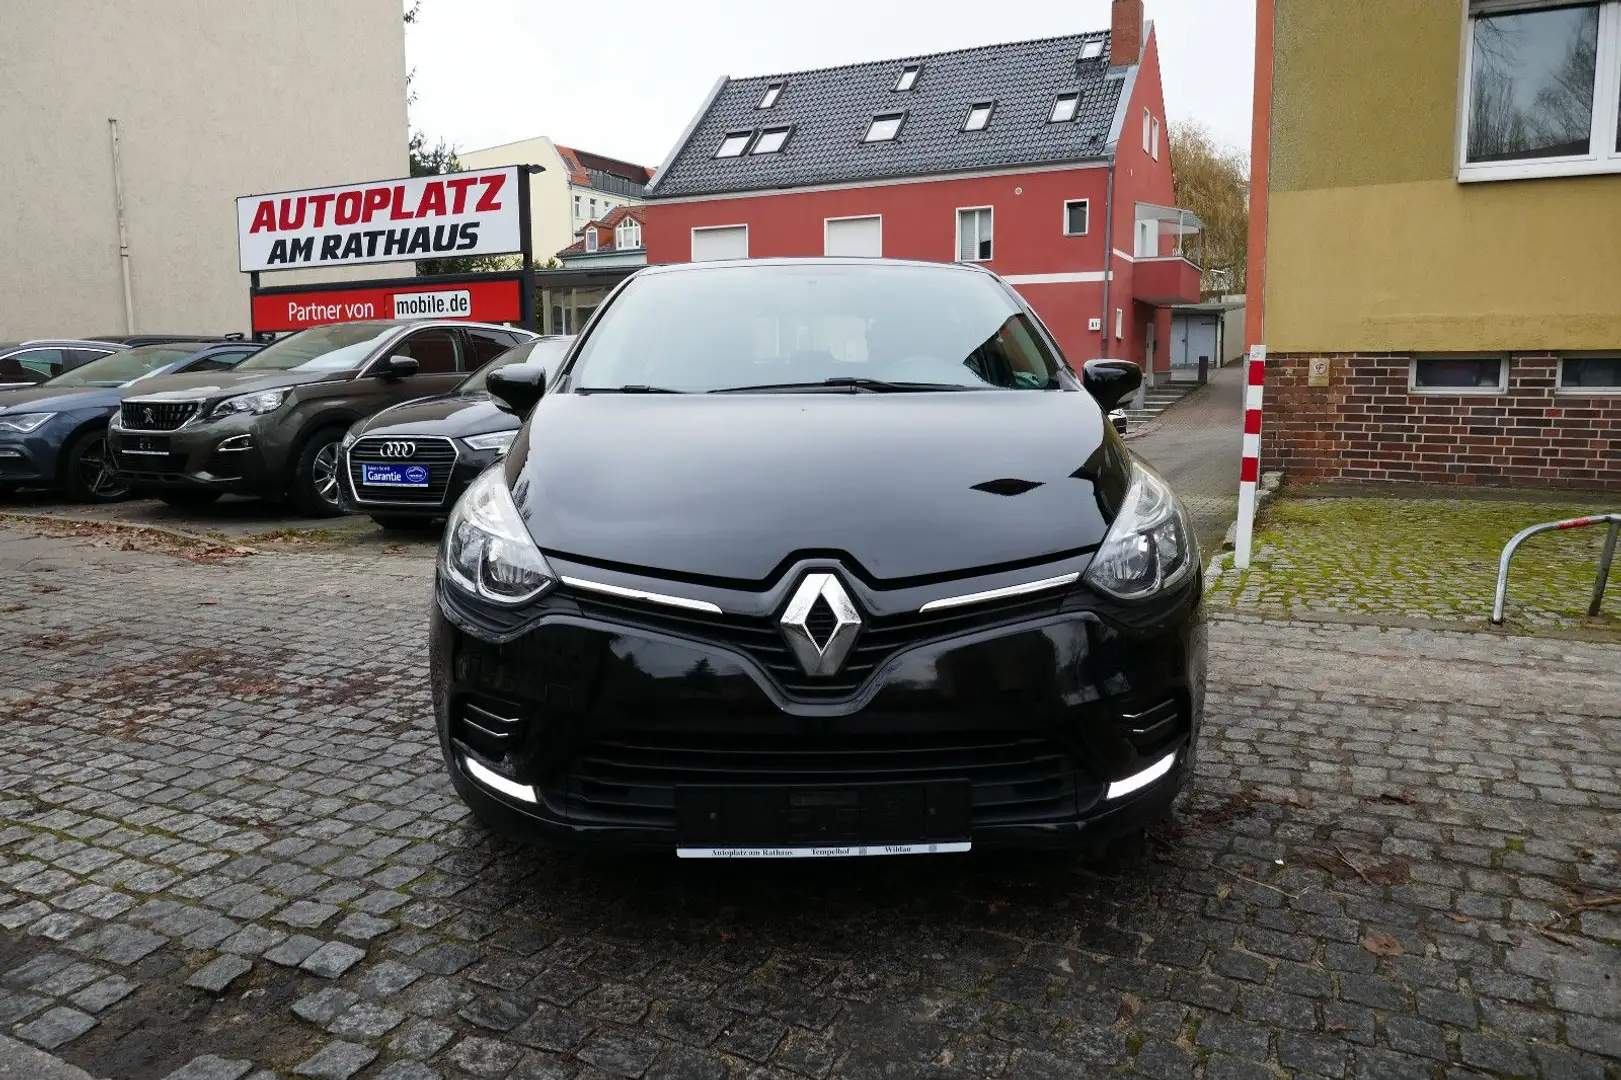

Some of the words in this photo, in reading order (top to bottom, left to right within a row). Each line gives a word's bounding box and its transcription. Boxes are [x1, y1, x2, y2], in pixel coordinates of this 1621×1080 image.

[250, 174, 506, 234] AUTOPLATZ
[267, 238, 316, 265] AM
[320, 222, 480, 260] RATHAUS
[288, 301, 342, 322] Partner
[346, 302, 374, 319] von
[396, 294, 468, 316] mobile.de
[368, 471, 401, 481] Garantie
[712, 849, 747, 858] Autoplatz
[811, 847, 850, 857] Tempelhof
[885, 845, 912, 853] Wildau
